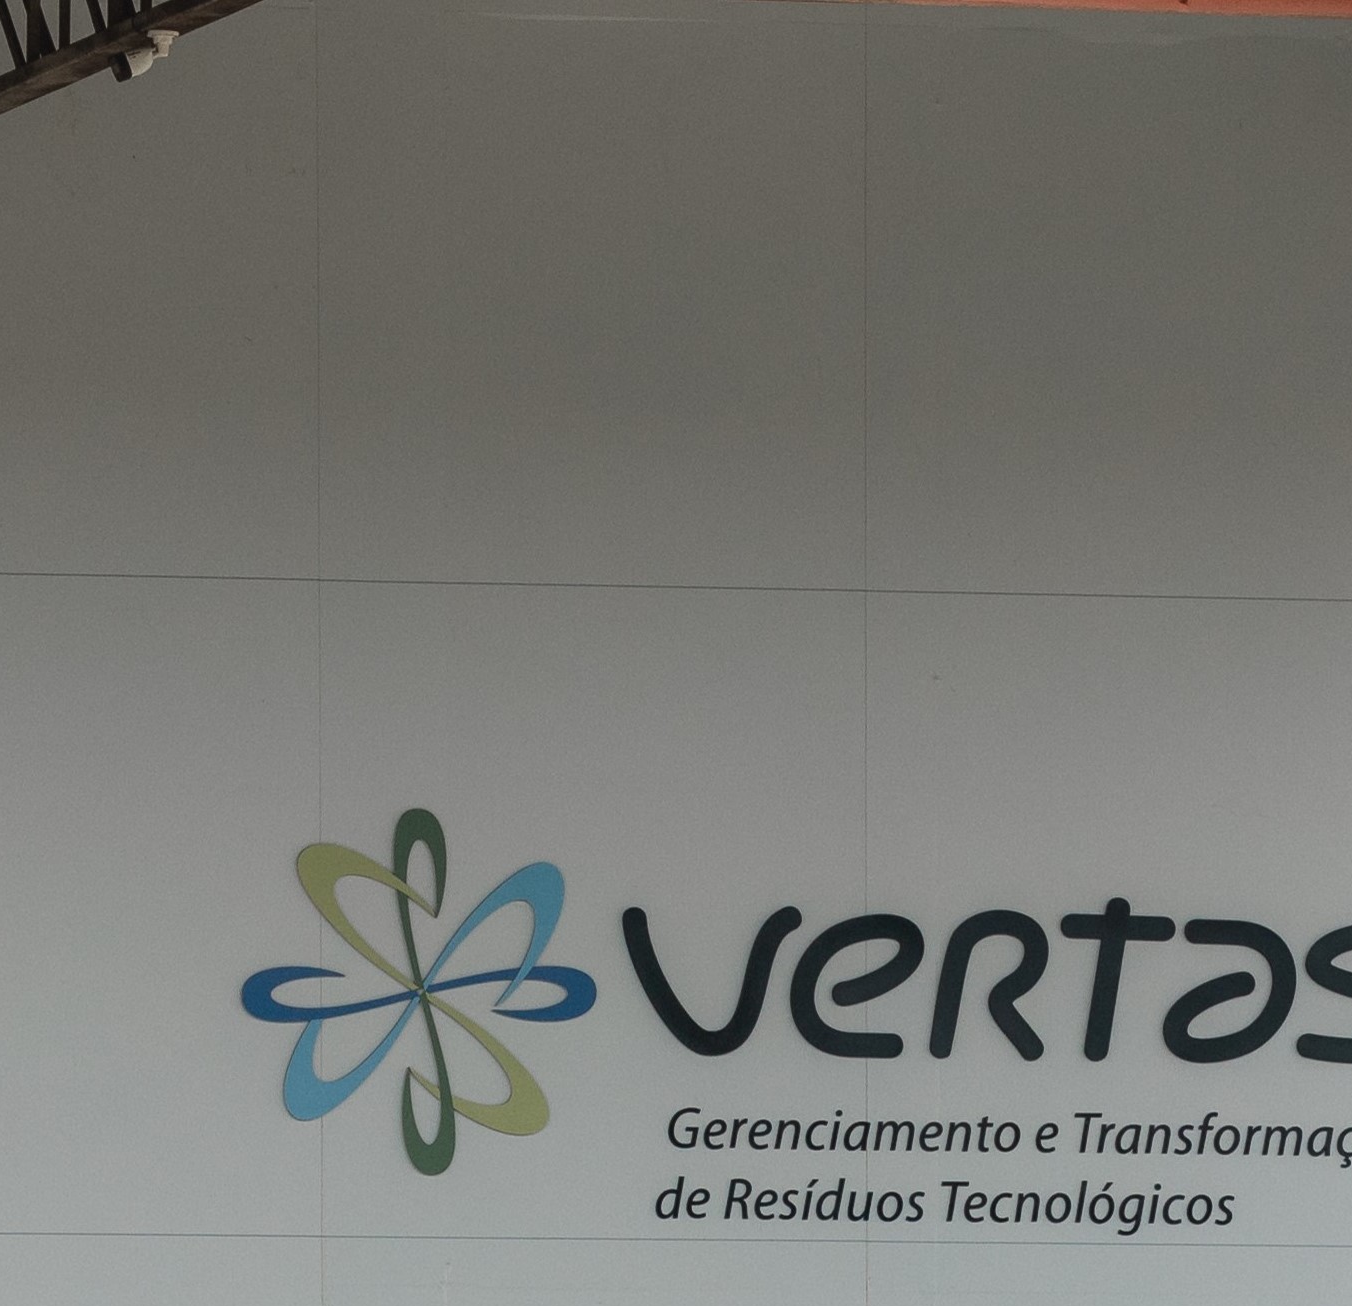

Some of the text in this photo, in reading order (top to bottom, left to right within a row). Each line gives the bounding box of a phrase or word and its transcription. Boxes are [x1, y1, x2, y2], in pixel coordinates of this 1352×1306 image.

[667, 1106, 1022, 1153] Gerenciamento
[1035, 1121, 1059, 1154] e
[654, 1175, 1236, 1237] de Resíduos Tecnológicos
